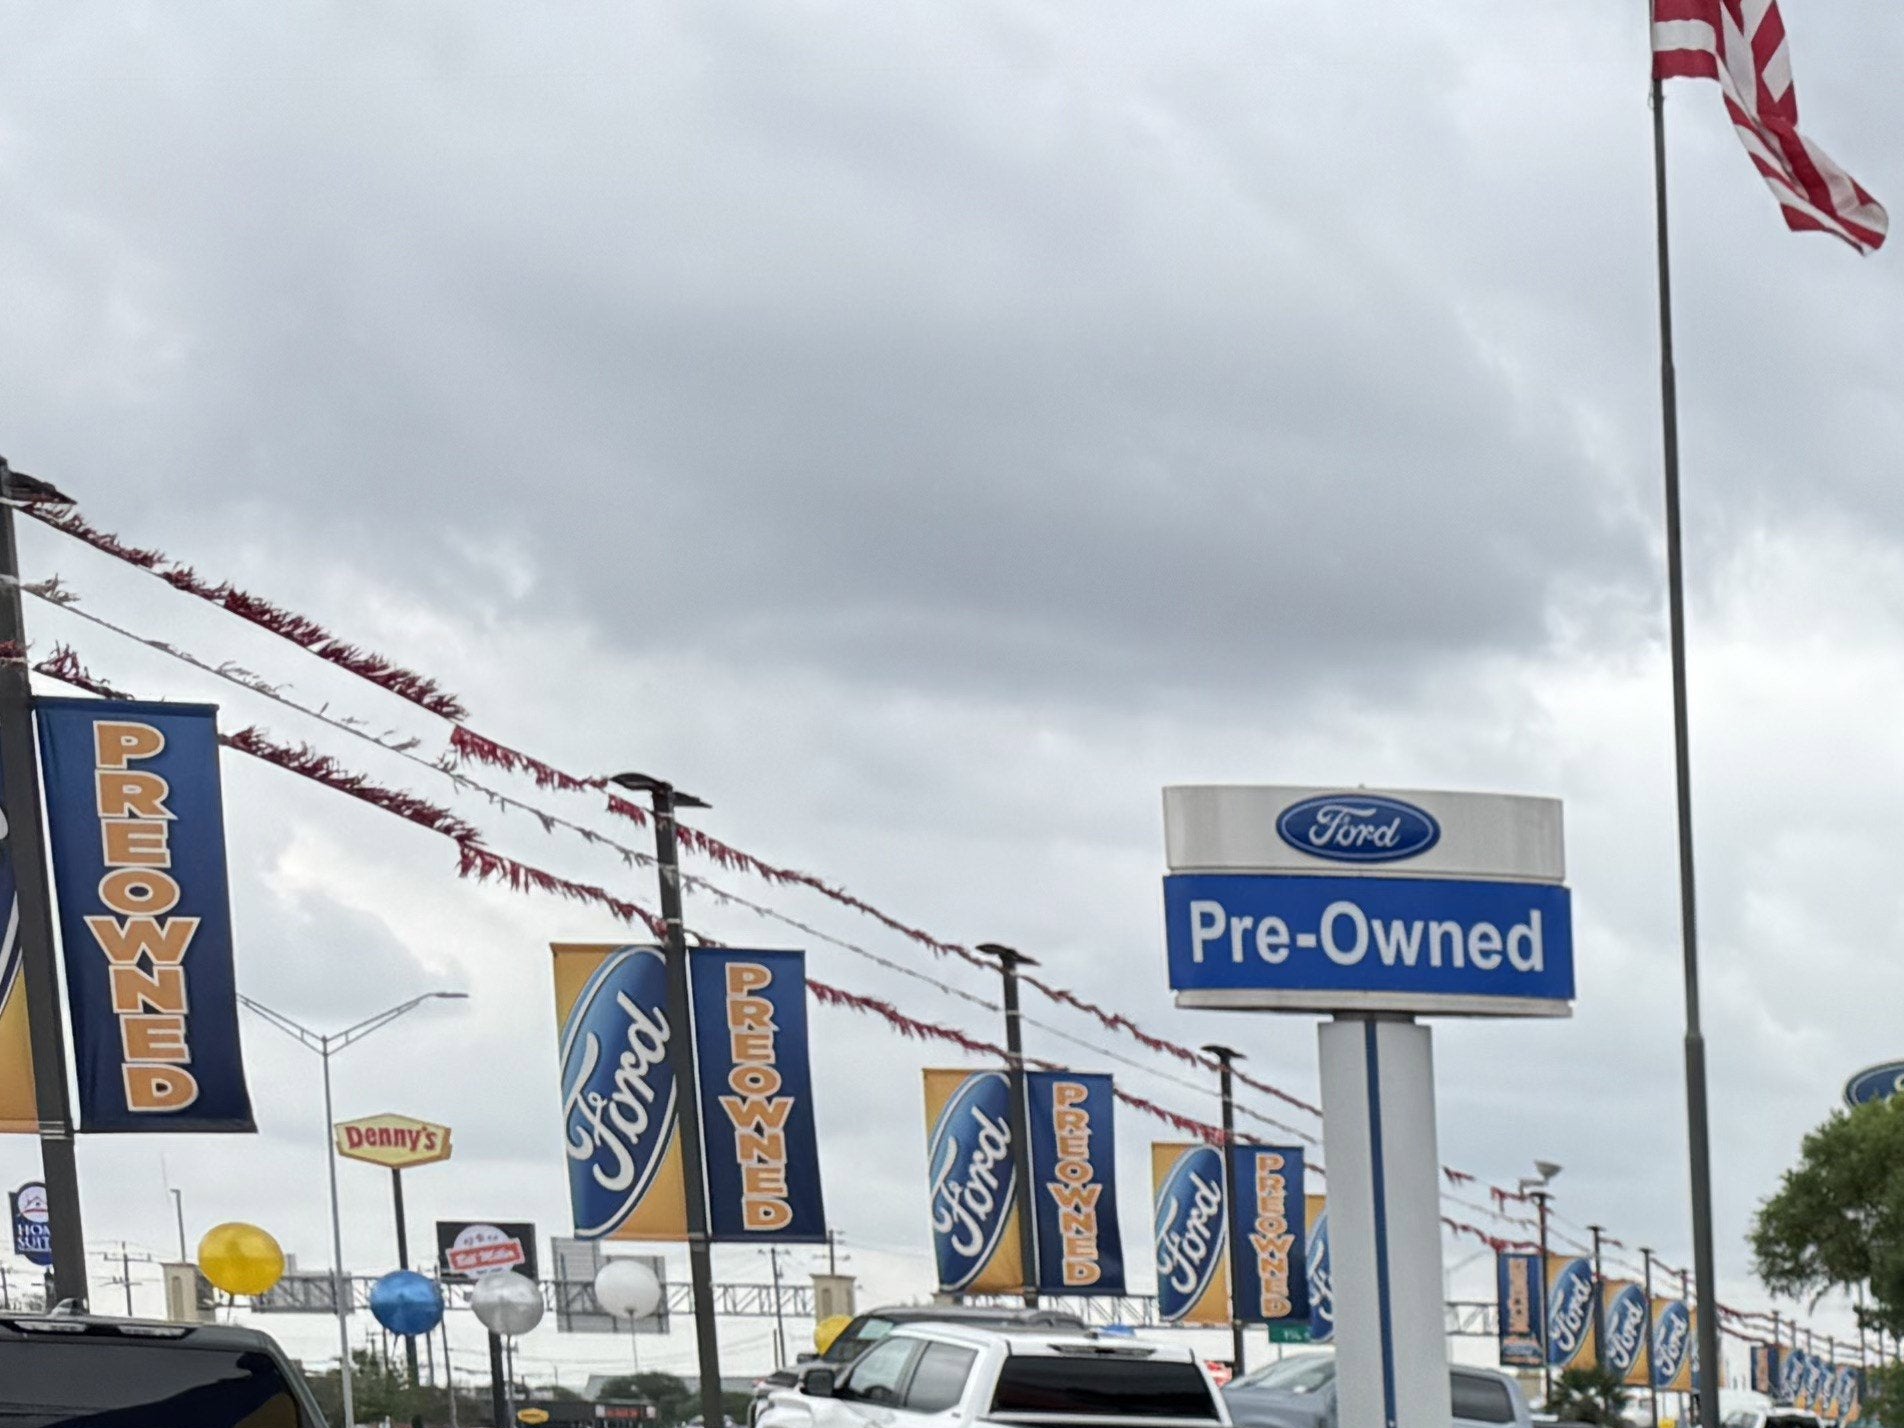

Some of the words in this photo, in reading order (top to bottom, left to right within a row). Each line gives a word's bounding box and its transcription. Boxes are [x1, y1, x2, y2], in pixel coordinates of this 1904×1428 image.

[1308, 803, 1401, 849] Ford
[84, 720, 201, 1113] PREOWNED
[1190, 900, 1544, 972] Pre-Owned
[345, 1125, 437, 1152] Denny's
[566, 990, 671, 1192] Ford
[718, 962, 795, 1231] PREOWNED
[932, 1106, 1013, 1258] Ford
[1047, 1082, 1102, 1287] PREOWNED
[1157, 1173, 1222, 1295] Ford
[1249, 1152, 1296, 1318] PREOWNED
[1549, 1273, 1592, 1352] Ford
[1608, 1297, 1644, 1369] Ford
[1655, 1312, 1688, 1377] Ford
